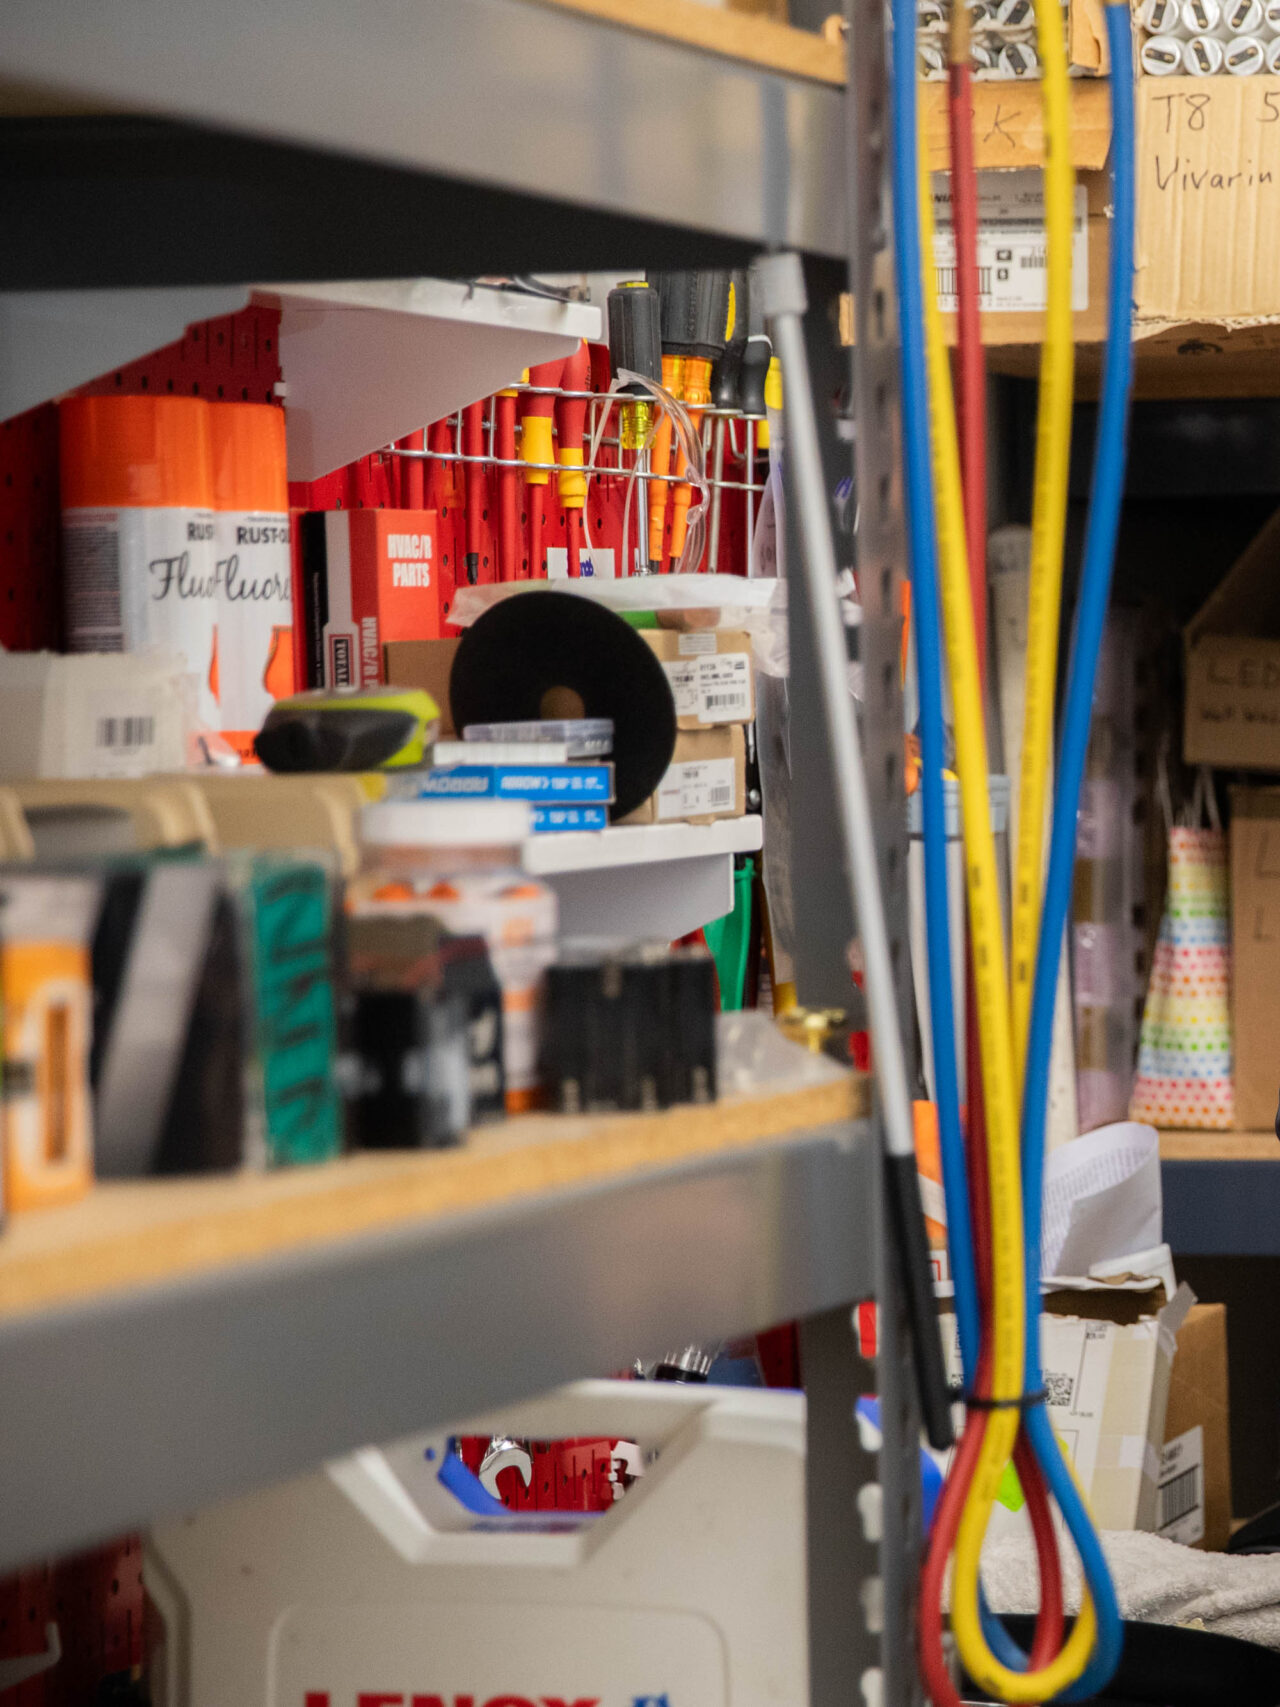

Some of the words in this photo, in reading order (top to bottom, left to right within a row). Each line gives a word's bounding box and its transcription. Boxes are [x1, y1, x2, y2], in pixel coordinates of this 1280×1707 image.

[1152, 92, 1212, 133] T8
[387, 534, 432, 559] HVAC/R
[392, 562, 430, 588] PARTS
